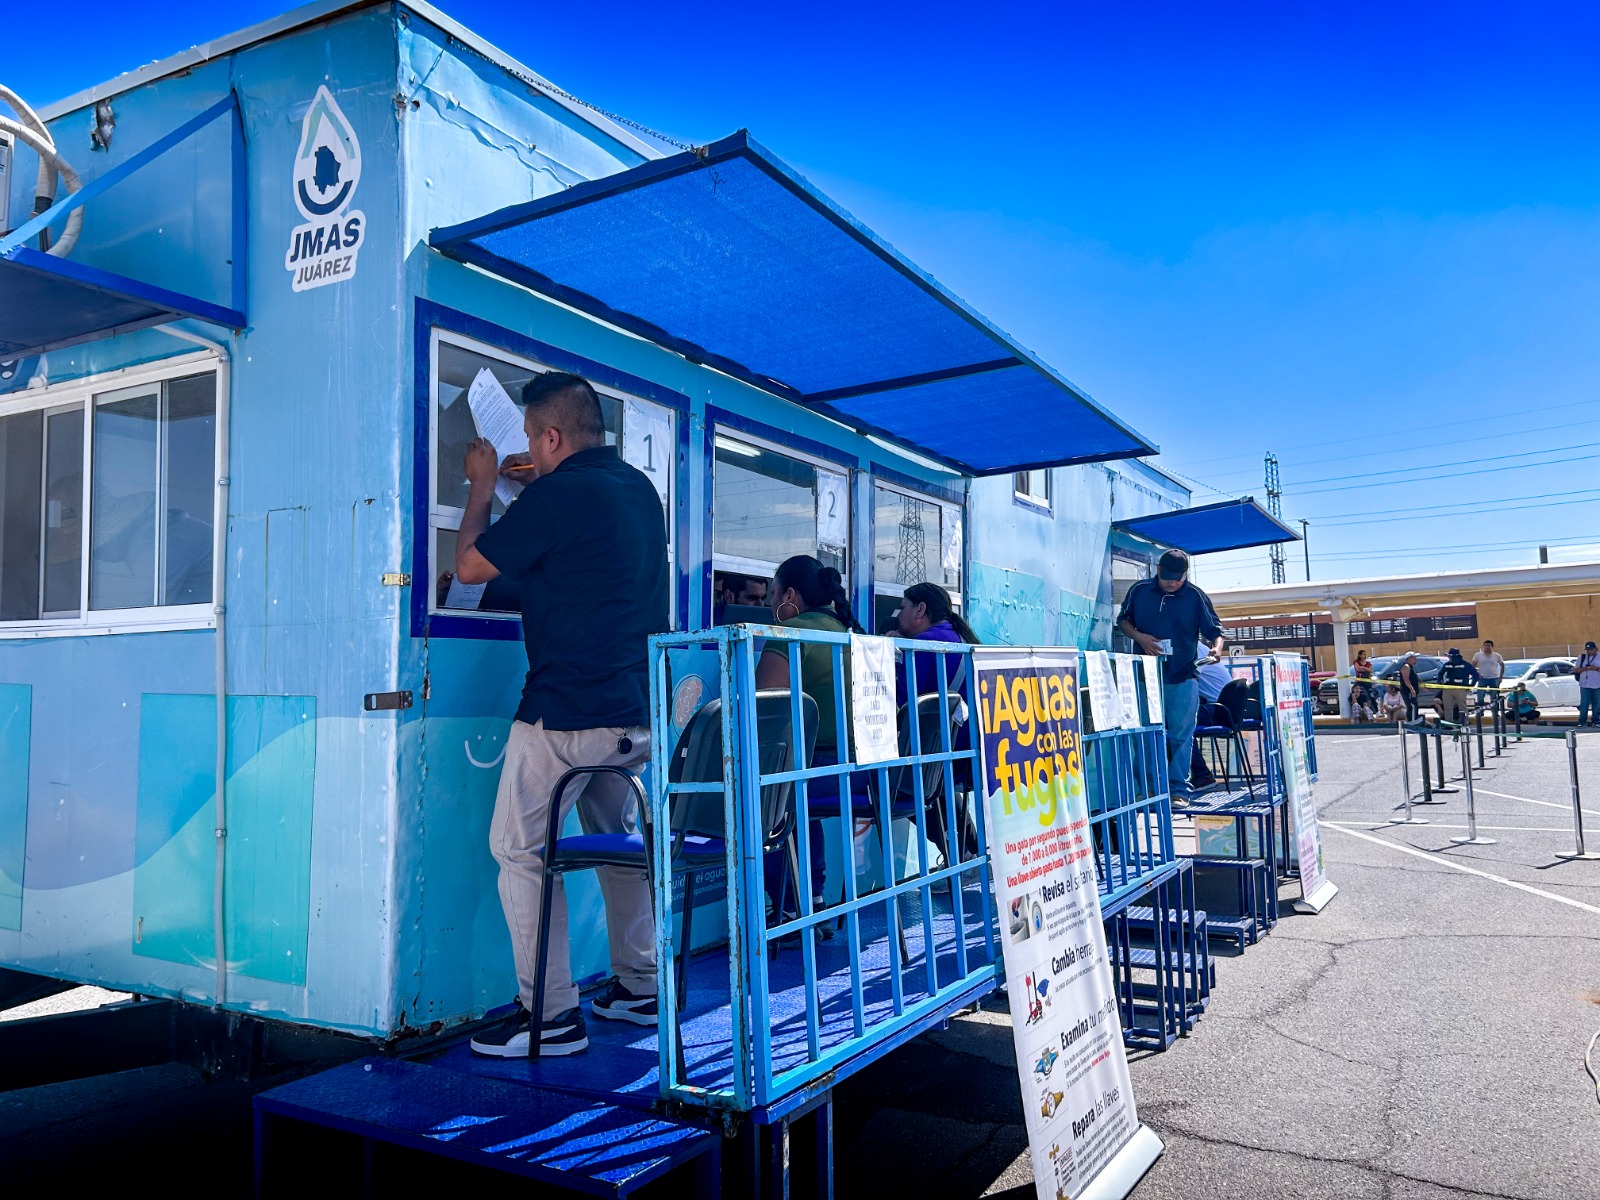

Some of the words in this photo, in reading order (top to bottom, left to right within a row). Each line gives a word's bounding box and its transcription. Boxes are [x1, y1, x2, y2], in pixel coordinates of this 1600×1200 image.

[290, 217, 361, 264] JMAS
[297, 254, 353, 285] JUÁREZ
[643, 433, 656, 473] 1
[827, 491, 836, 519] 2
[1036, 730, 1057, 754] con
[1057, 722, 1074, 750] las
[1005, 842, 1017, 855] Una
[1017, 838, 1029, 854] gota
[1029, 835, 1037, 850] por
[1036, 828, 1056, 845] segundo
[1056, 826, 1070, 840] pued
[1021, 852, 1029, 866] de
[1057, 839, 1071, 852] litros
[695, 870, 704, 884] el
[704, 868, 726, 882] agua
[1007, 875, 1018, 889] Una
[1017, 871, 1029, 884] llave
[1028, 865, 1043, 881] abierta
[1042, 863, 1053, 878] gasta
[1052, 858, 1064, 871] hasta
[1042, 880, 1065, 904] Revisa
[1066, 874, 1074, 893] el
[1052, 947, 1075, 976] Cambia
[1060, 1018, 1089, 1051] Examina
[1089, 1012, 1097, 1029] tu
[1072, 1108, 1095, 1141] Repara
[1094, 1099, 1103, 1118] las
[1102, 1086, 1120, 1110] llaves
